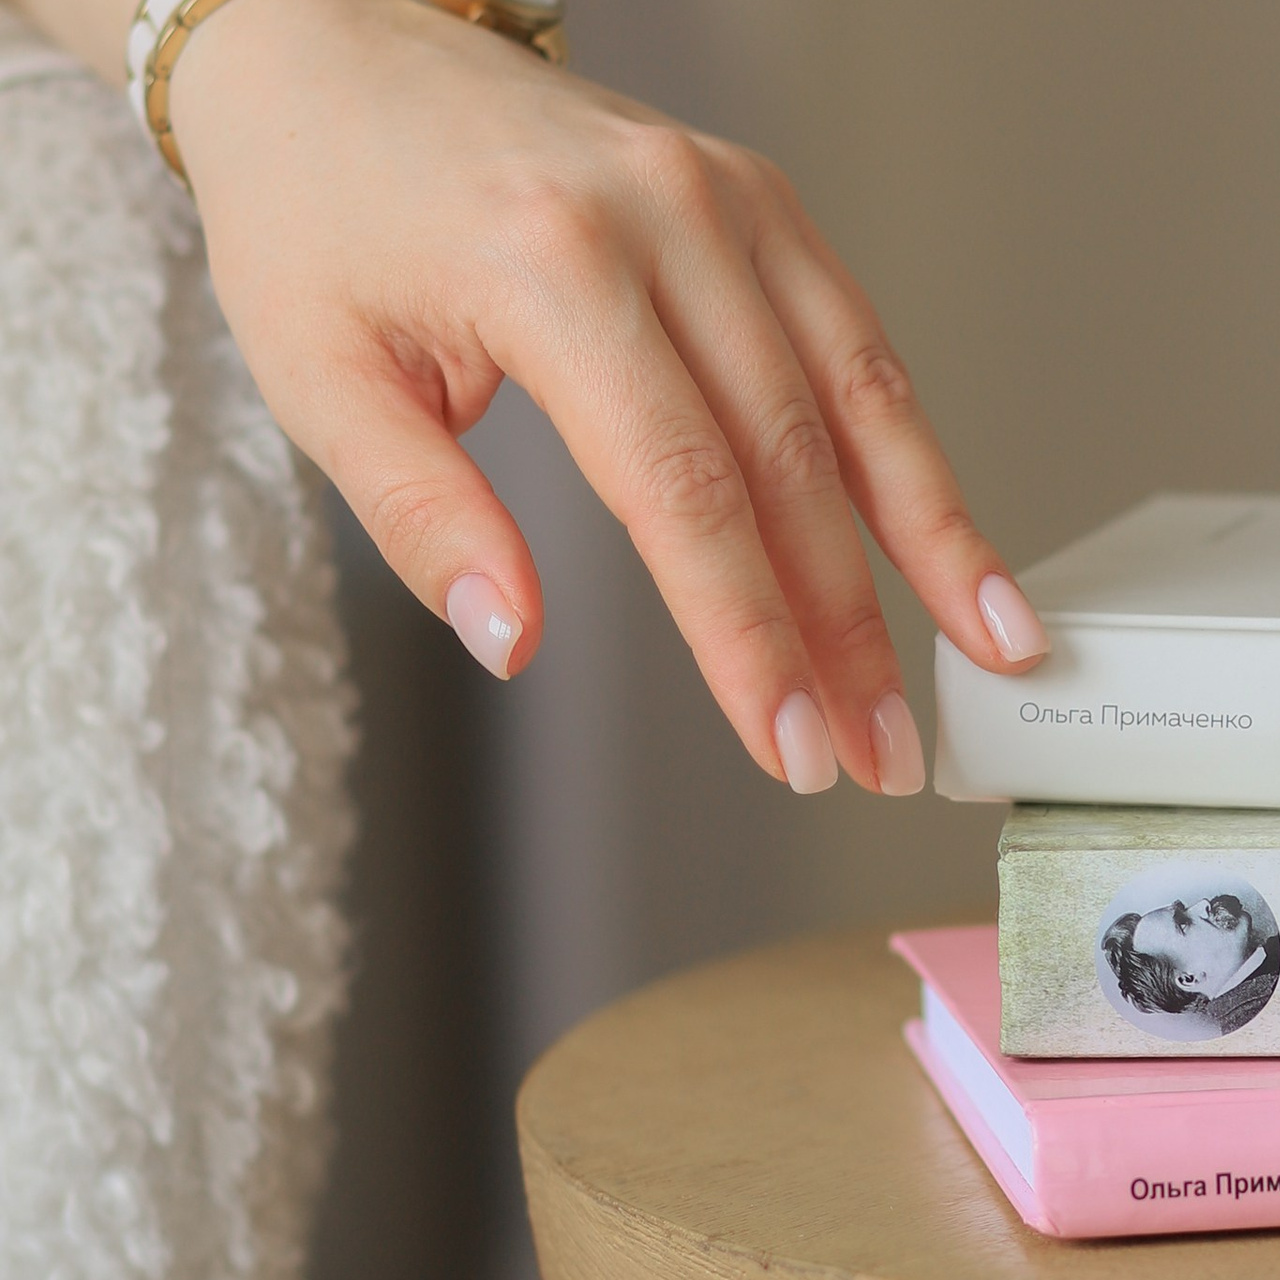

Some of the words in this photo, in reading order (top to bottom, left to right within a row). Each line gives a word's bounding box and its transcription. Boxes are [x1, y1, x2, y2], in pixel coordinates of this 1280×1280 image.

[1019, 702, 1093, 727] Ольга
[1101, 705, 1254, 731] Примаченко
[1130, 1177, 1206, 1200] Ольга
